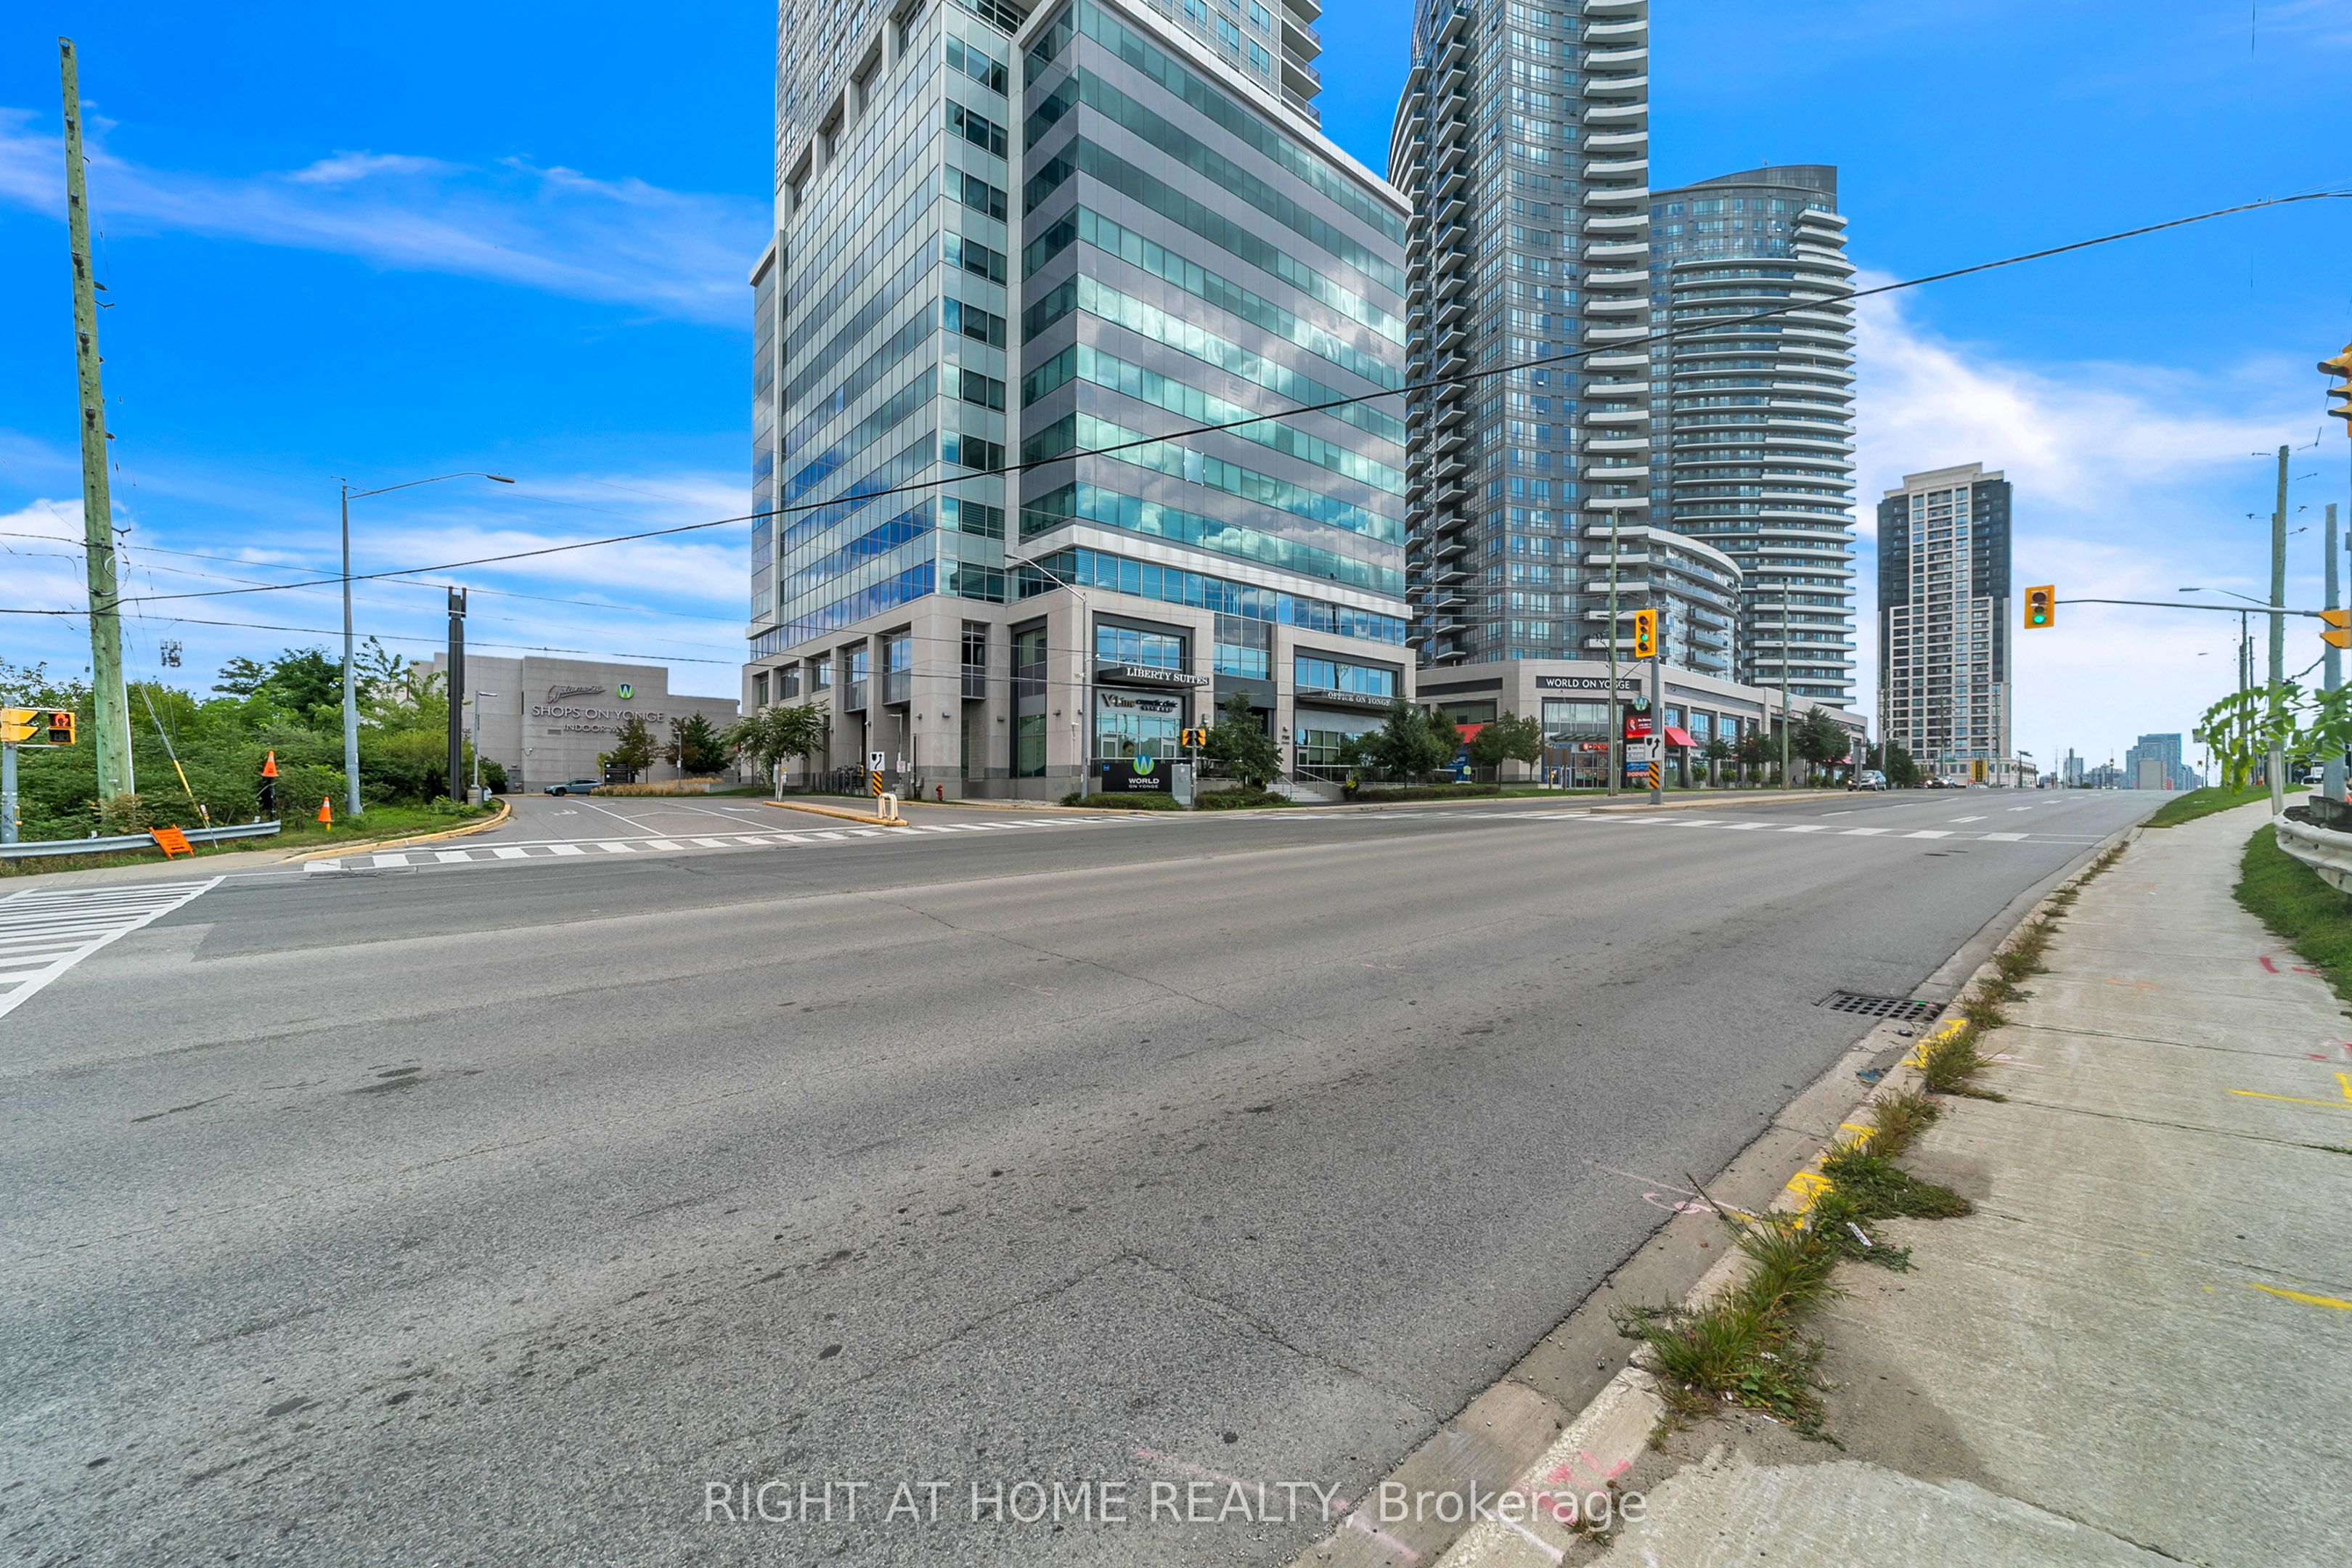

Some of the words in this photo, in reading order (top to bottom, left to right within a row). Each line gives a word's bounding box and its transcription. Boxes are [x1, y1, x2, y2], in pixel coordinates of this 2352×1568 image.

[1126, 666, 1172, 681] LIBERTY
[1173, 674, 1209, 685] SUITES
[1545, 678, 1580, 688] WORLD
[1582, 679, 1597, 688] ON
[1598, 680, 1630, 690] YOGE
[1328, 691, 1355, 702] OFFICE
[531, 704, 581, 719] SHOPS
[584, 708, 610, 719] ON
[614, 709, 664, 723] YONGE
[563, 723, 605, 733] INDOOR
